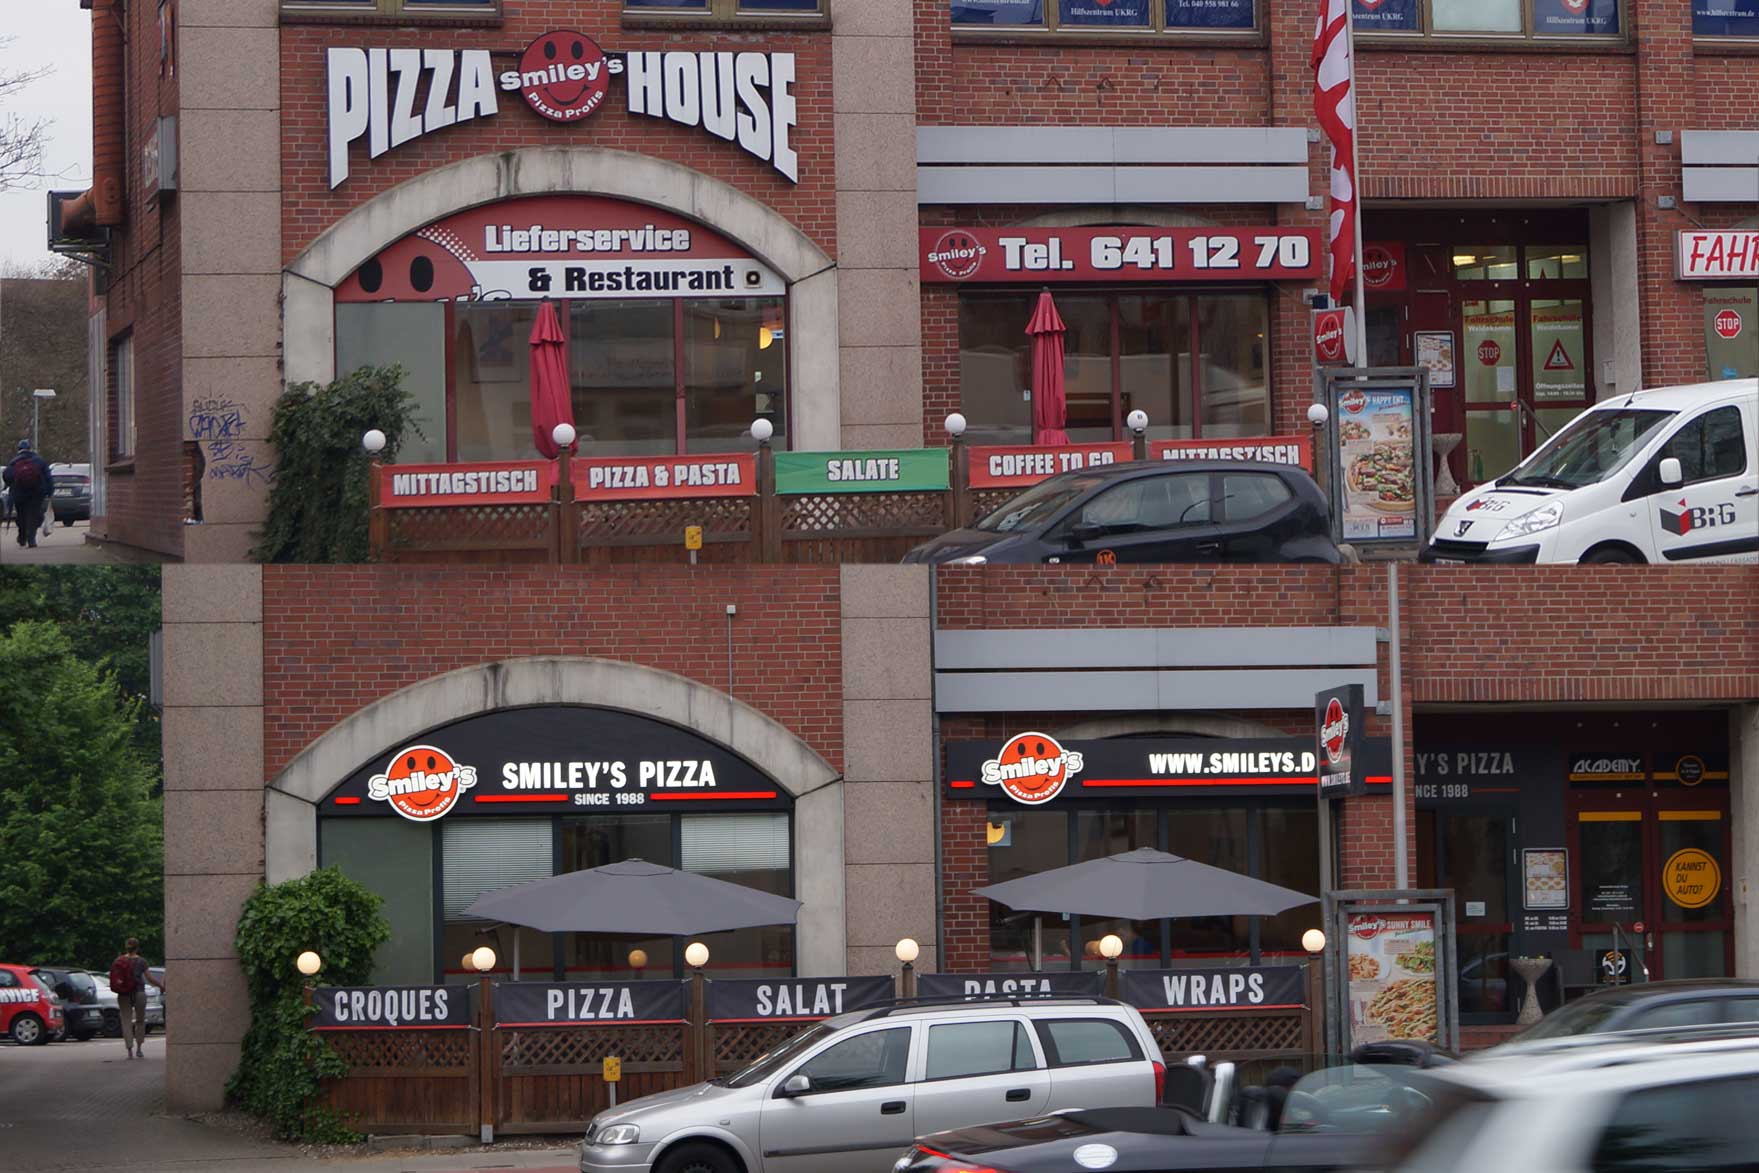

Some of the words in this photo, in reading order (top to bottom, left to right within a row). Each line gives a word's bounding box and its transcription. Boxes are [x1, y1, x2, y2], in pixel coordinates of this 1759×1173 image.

[1115, 8, 1138, 17] UKRG
[500, 56, 624, 90] Smiley's
[528, 92, 562, 118] Pizza
[565, 90, 604, 118] Profis
[327, 47, 498, 190] PIZZA
[627, 50, 798, 185] HOUSE
[484, 225, 692, 253] Lieferservice
[927, 244, 987, 262] Smiley's
[999, 237, 1073, 271] Tel.
[1090, 236, 1174, 270] 641
[1188, 236, 1240, 269] 12
[1254, 235, 1310, 269] 70
[528, 267, 551, 292] &
[565, 265, 734, 292] Restaurant
[1717, 318, 1739, 330] STOP
[1478, 347, 1500, 359] STOP
[589, 465, 650, 488] PIZZA
[655, 465, 669, 487] &
[674, 462, 741, 486] PASTA
[828, 457, 899, 481] SALATE
[989, 453, 1055, 476] COFFEE
[1060, 452, 1083, 472] TO
[393, 469, 538, 495] MITTAGSTISCH
[502, 761, 626, 790] SMILEY'S
[639, 760, 716, 787] PIZZA
[984, 753, 1082, 782] Smiley's
[1149, 752, 1316, 774] WWW.SMILEYS.D
[1457, 752, 1514, 775] PIZZA
[372, 767, 475, 798] Smiley's
[1415, 784, 1437, 798] NCE
[1441, 784, 1468, 798] 1988
[574, 793, 610, 805] SINCE
[615, 792, 645, 805] 1988
[1676, 873, 1688, 883] DU
[1386, 919, 1410, 929] SUNNY
[1410, 919, 1431, 929] SMILE
[757, 982, 847, 1016] SALAT
[965, 979, 1052, 1001] PASTA
[1163, 973, 1265, 1006] WRAPS
[334, 989, 449, 1026] CROQUES
[547, 988, 635, 1020] PIZZA
